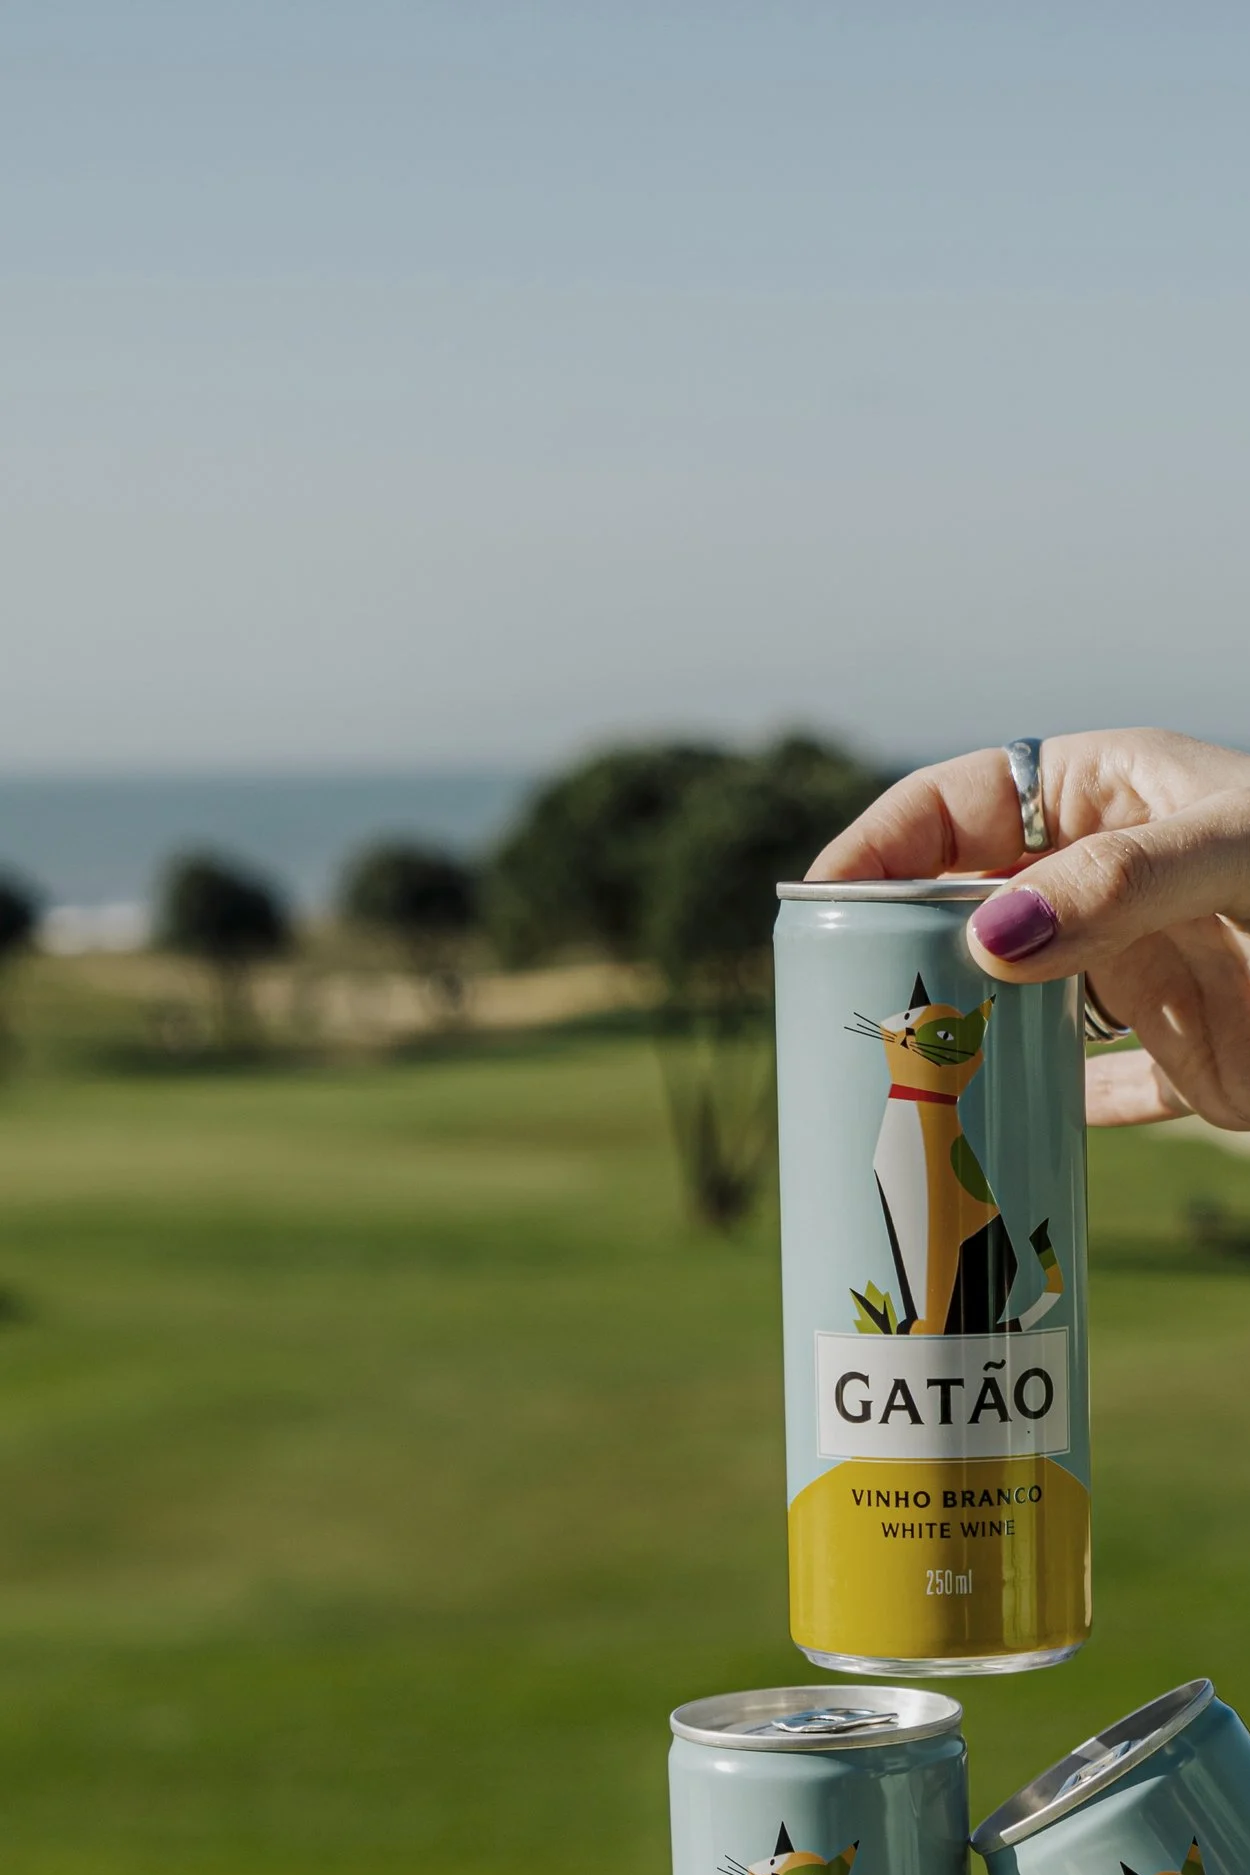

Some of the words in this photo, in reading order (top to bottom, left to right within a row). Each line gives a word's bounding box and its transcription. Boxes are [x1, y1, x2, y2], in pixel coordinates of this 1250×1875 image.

[834, 1359, 1054, 1425] GATÃO
[852, 1489, 931, 1508] VINHO
[942, 1485, 1042, 1508] BRANCO
[881, 1522, 951, 1539] WHITE
[960, 1519, 1016, 1538] WINE
[926, 1569, 973, 1595] 250ml
